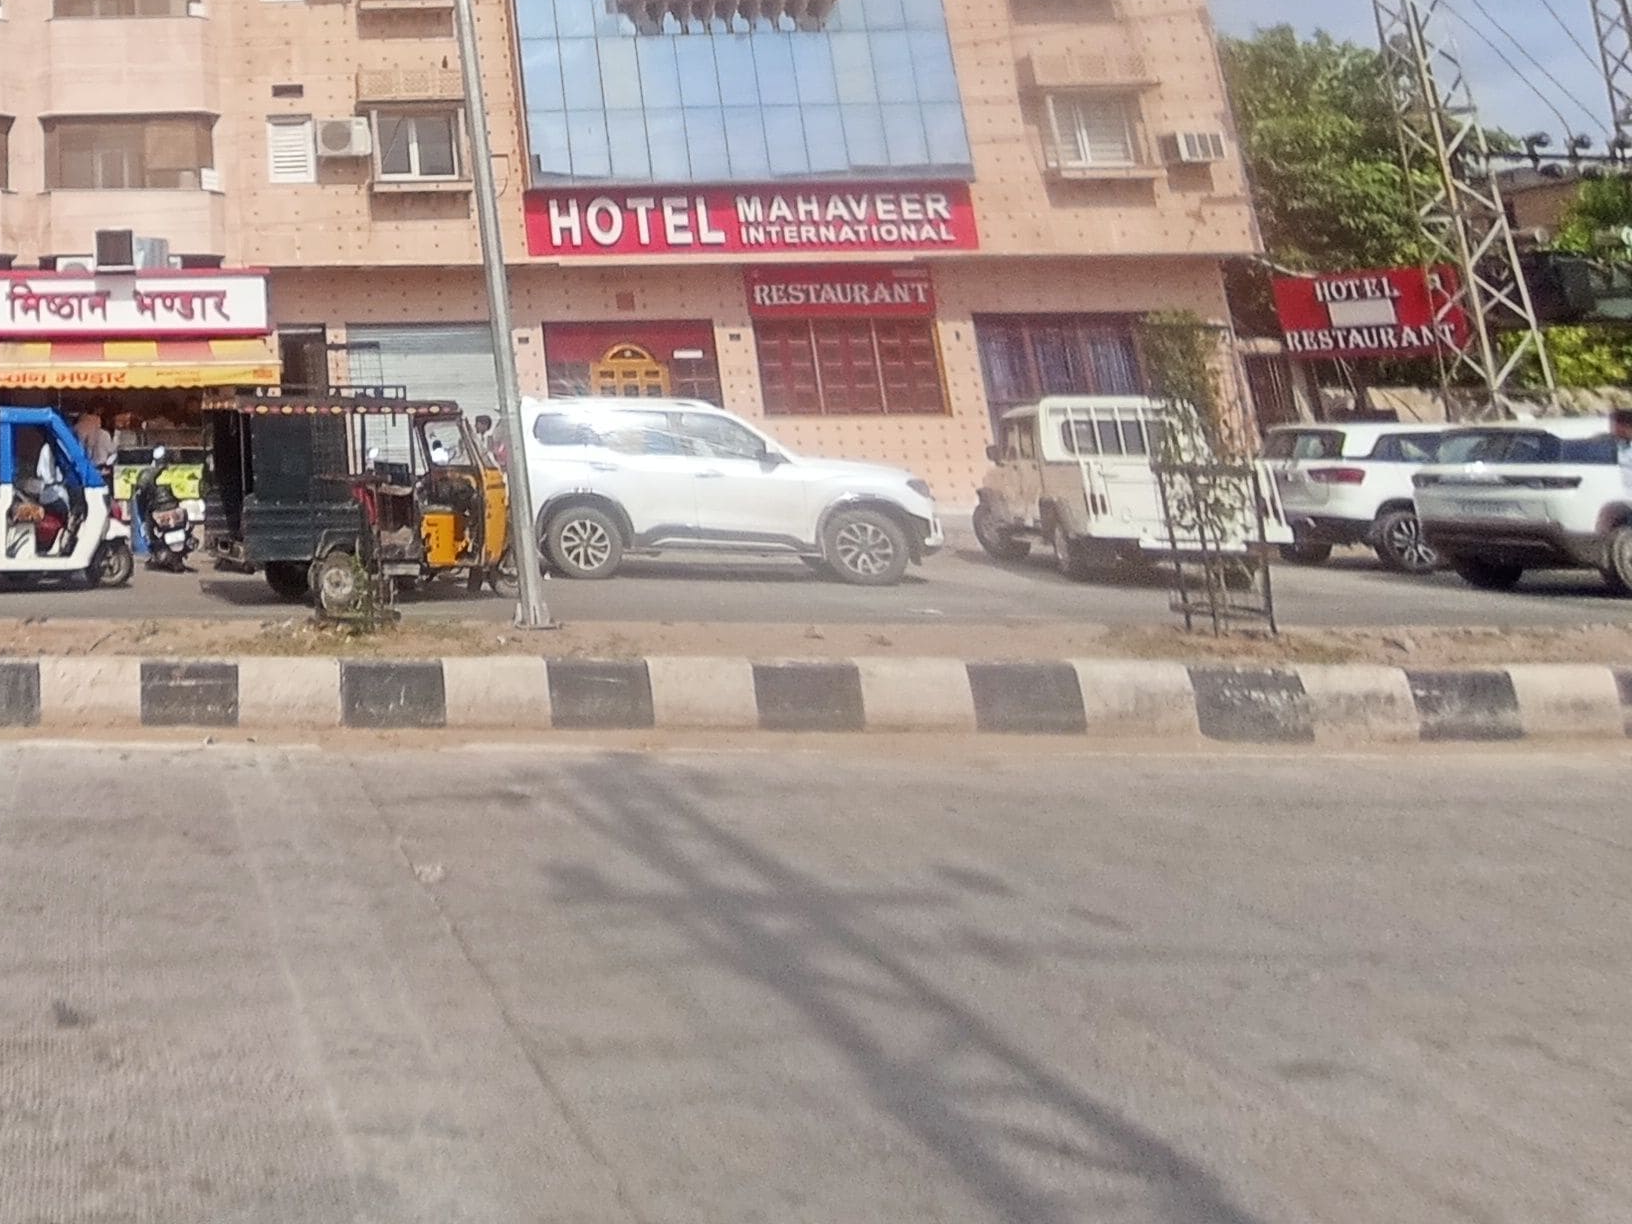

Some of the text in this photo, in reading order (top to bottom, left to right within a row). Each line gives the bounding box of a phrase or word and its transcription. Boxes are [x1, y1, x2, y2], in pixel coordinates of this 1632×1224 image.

[548, 192, 952, 246] HOTEL MAHAVEER
[741, 223, 957, 245] INTERNATIONAL
[6, 278, 111, 323] मिष्ठान
[132, 289, 230, 322] भण्डार
[753, 280, 928, 306] RESTAURANT
[1314, 276, 1400, 302] HOTEL
[1286, 323, 1455, 353] RESTAURANT
